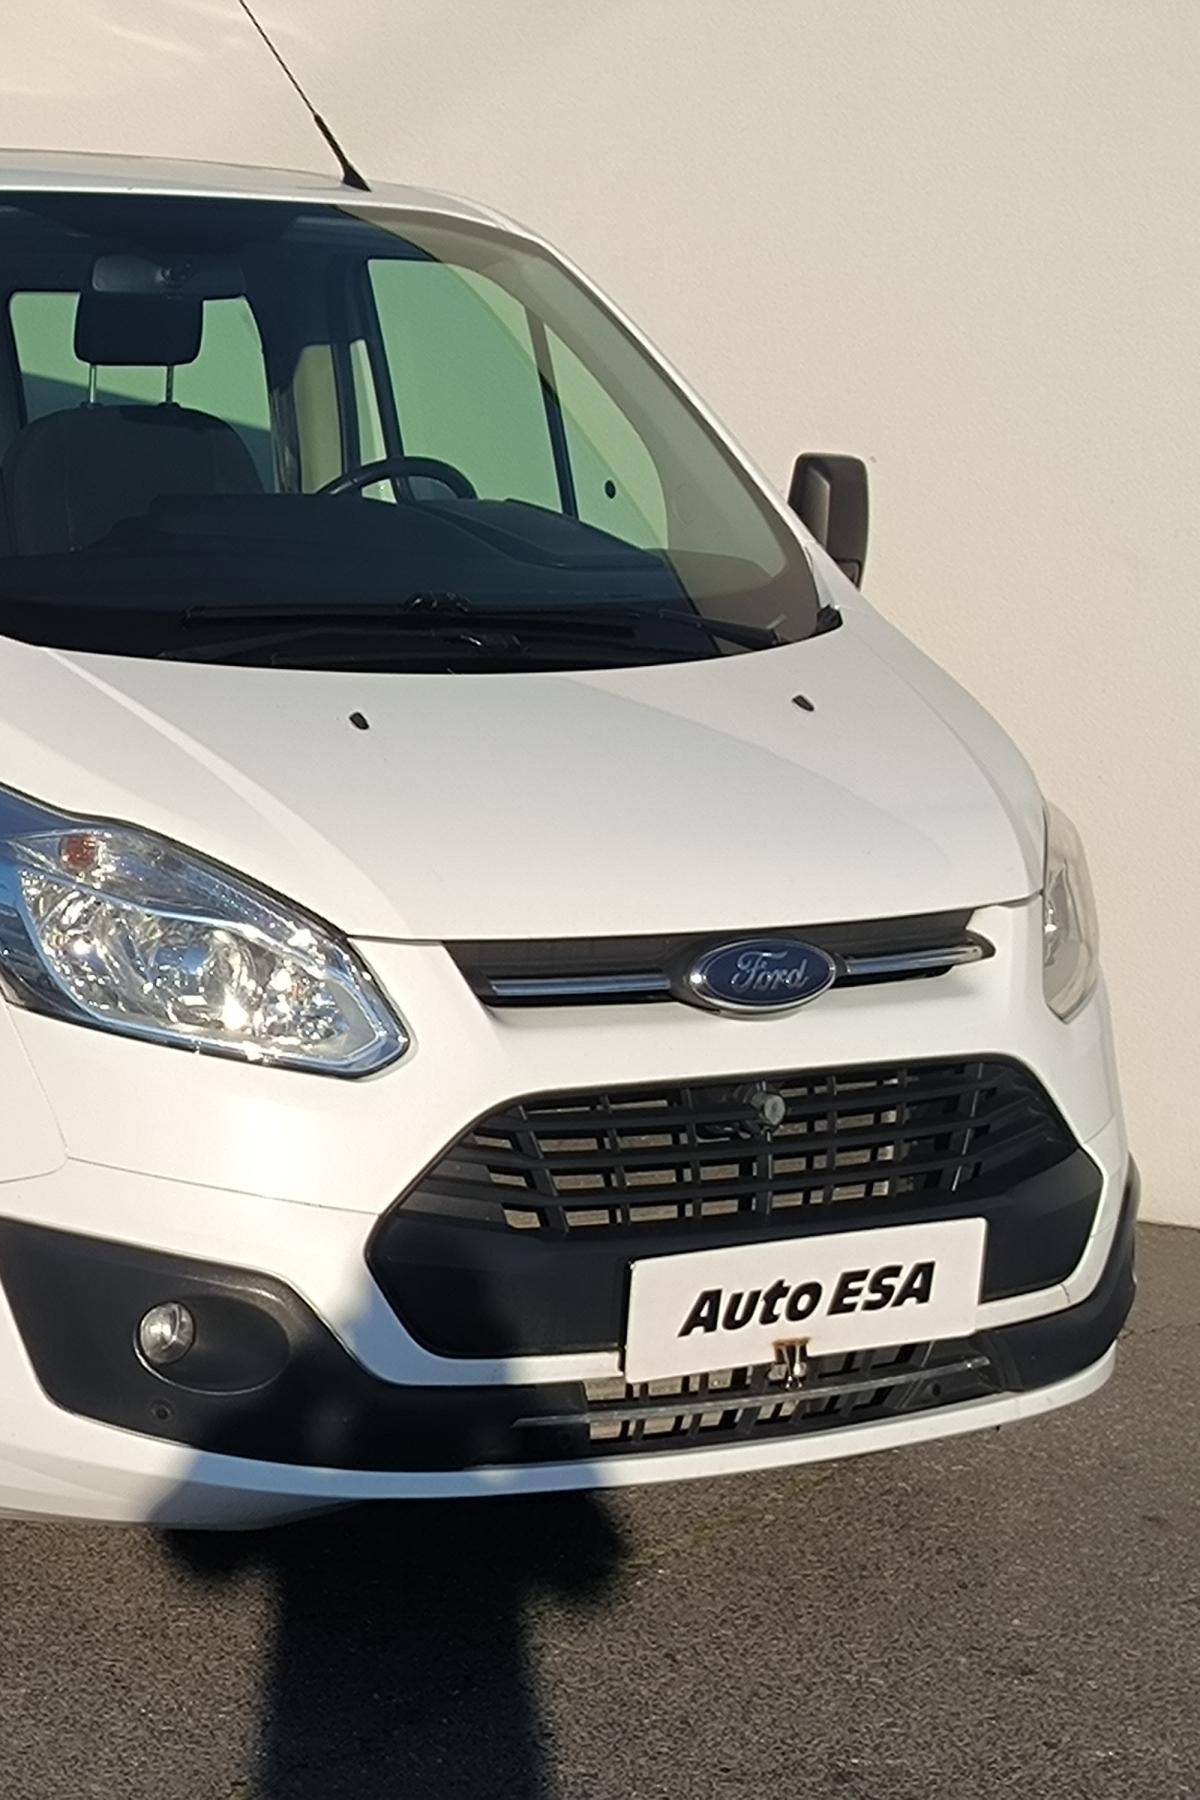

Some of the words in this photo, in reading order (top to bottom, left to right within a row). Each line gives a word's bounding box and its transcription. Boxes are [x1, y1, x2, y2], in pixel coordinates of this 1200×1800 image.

[731, 951, 809, 993] Ford
[677, 1279, 823, 1338] Auto
[827, 1260, 936, 1316] ESA
